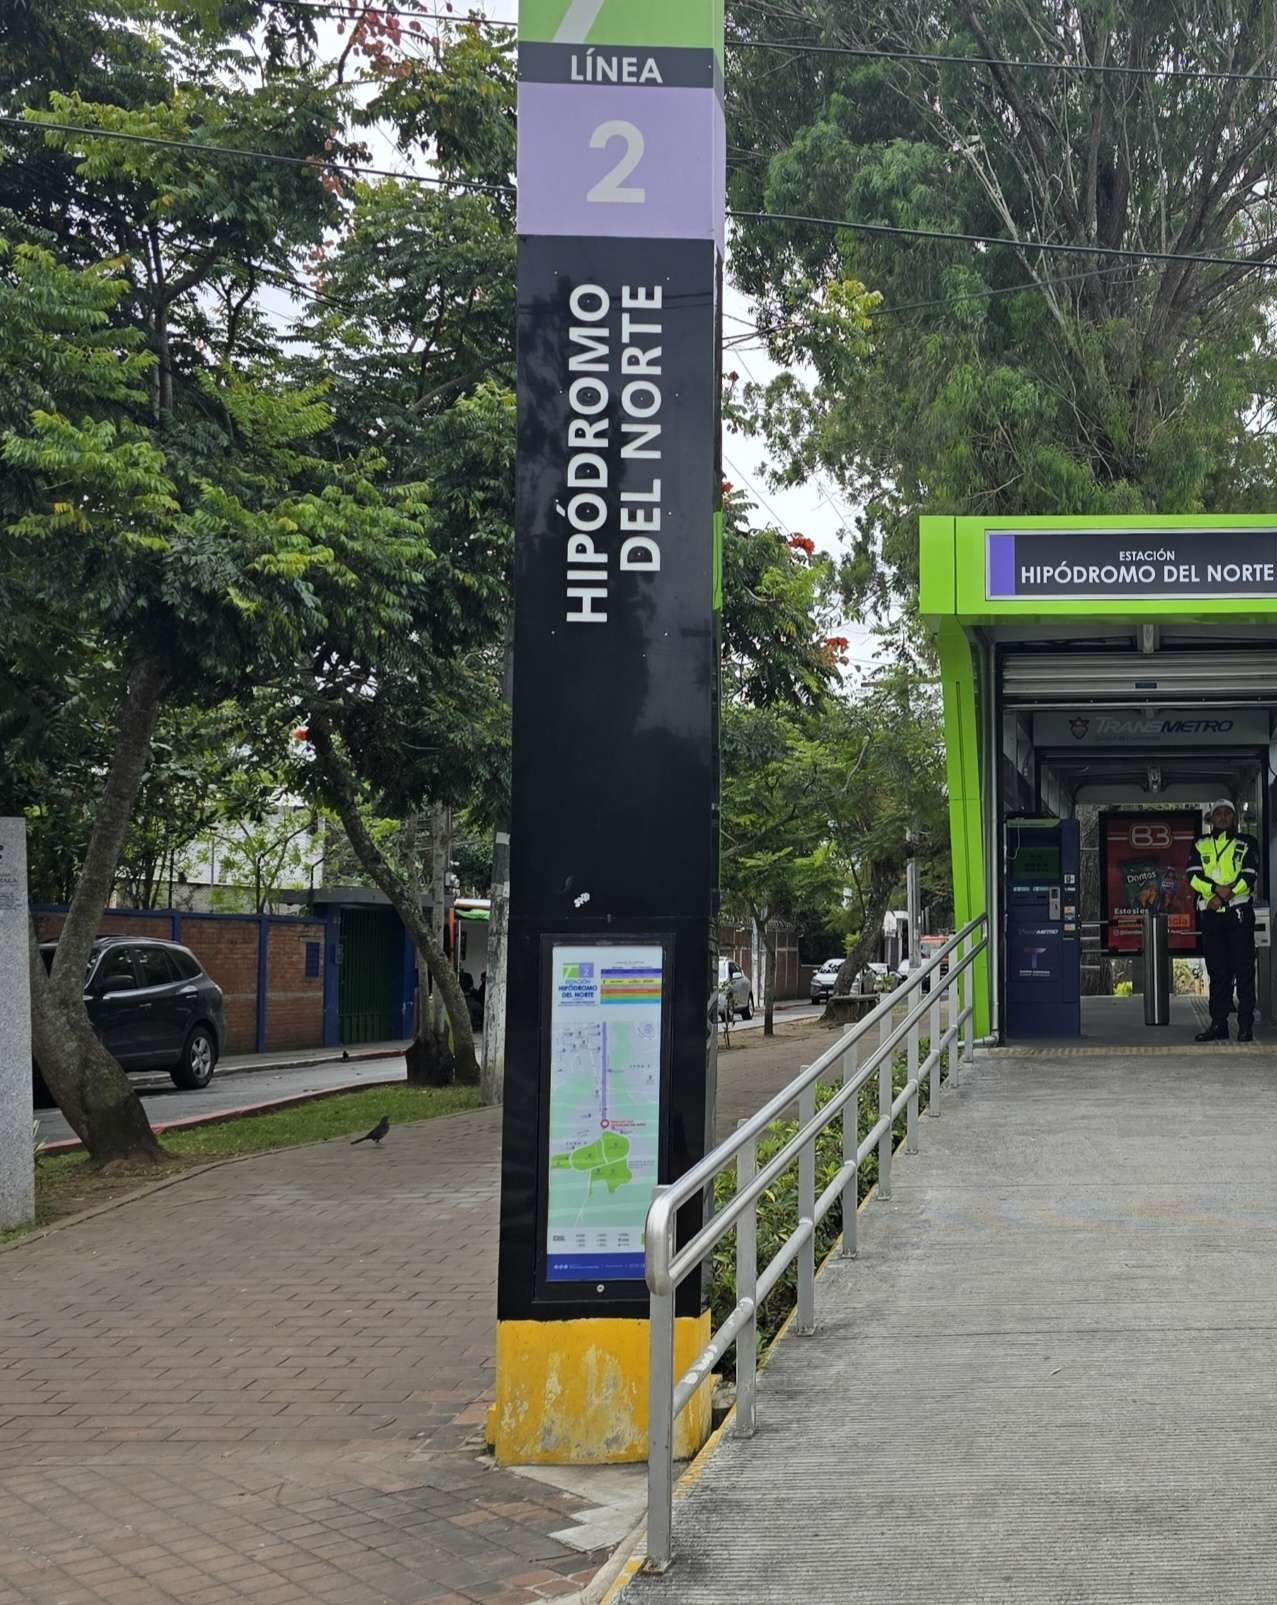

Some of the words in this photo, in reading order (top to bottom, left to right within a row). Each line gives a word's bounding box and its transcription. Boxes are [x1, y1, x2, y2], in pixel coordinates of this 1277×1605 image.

[570, 47, 664, 84] LÍNEA
[586, 119, 646, 203] 2
[620, 284, 663, 459] NORTE
[556, 283, 611, 623] HIPÓDROMO
[620, 478, 662, 572] DEL
[1119, 548, 1176, 562] ESTACIÓN
[1020, 560, 1156, 585] HIPÓDROMO
[1162, 565, 1201, 583] DEL
[1207, 563, 1275, 582] NORTE
